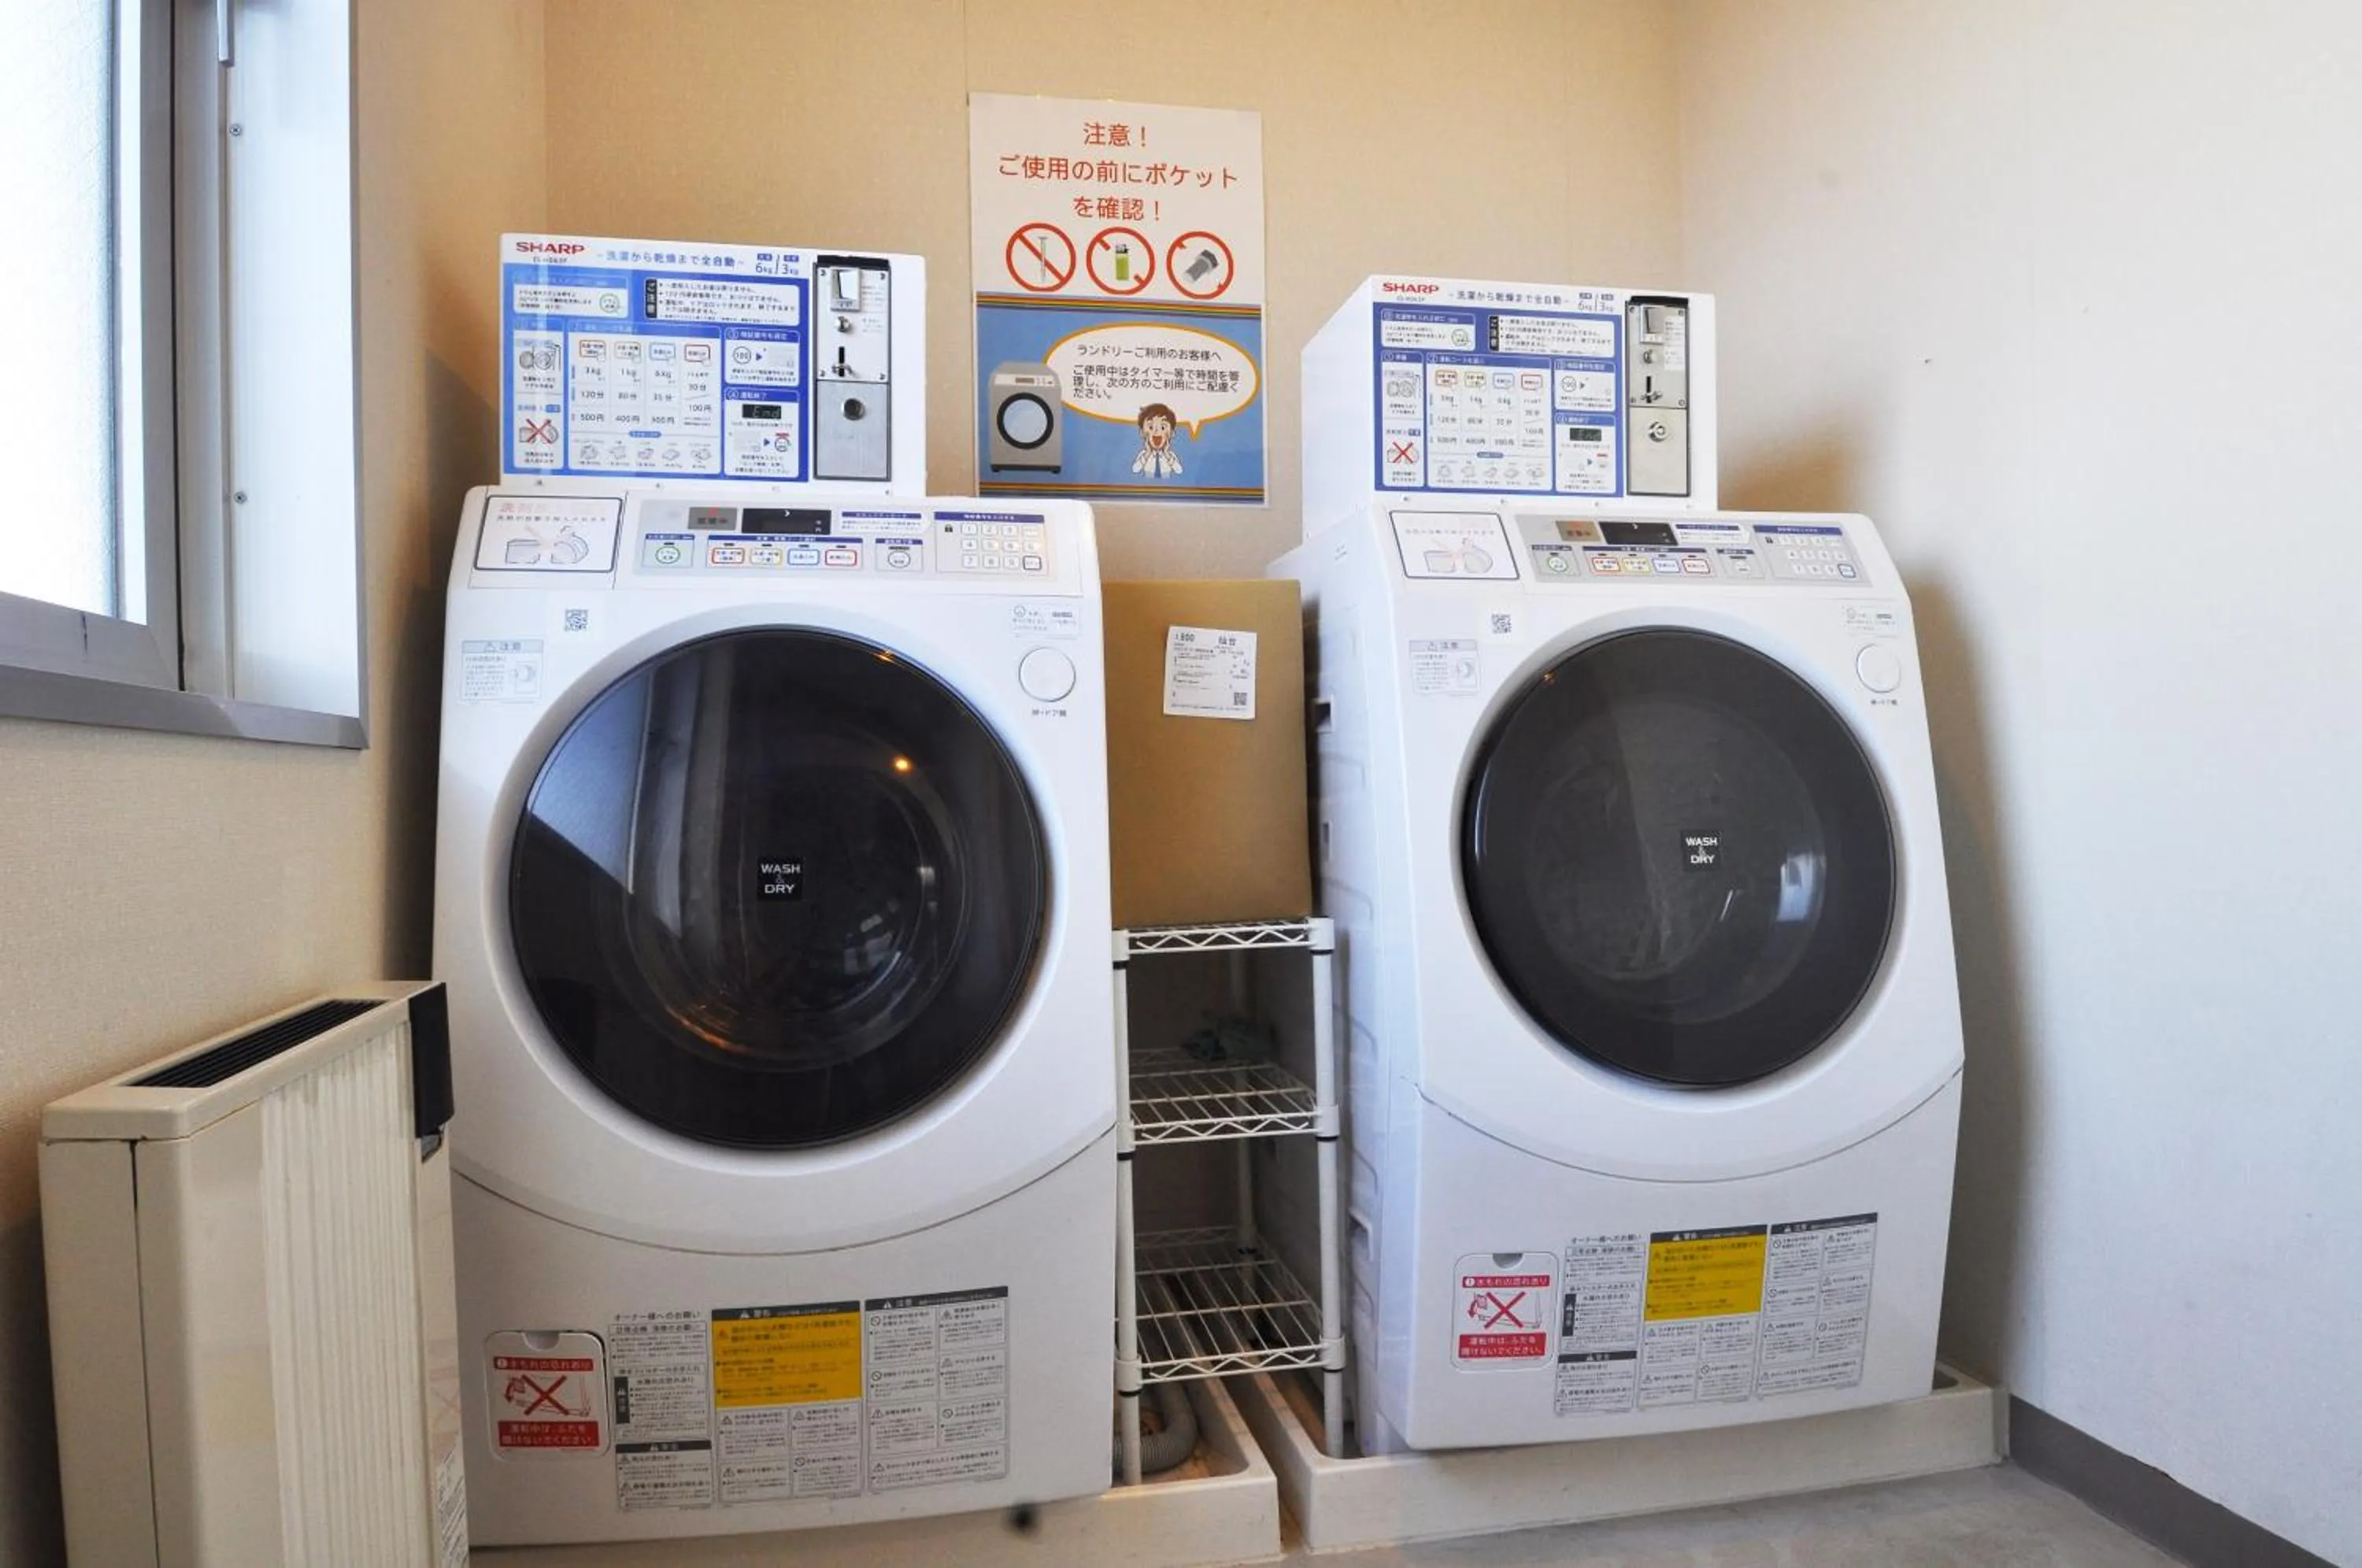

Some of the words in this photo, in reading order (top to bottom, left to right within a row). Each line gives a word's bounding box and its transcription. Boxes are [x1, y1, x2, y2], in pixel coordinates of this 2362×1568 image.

[1083, 124, 1146, 146] 注意！
[999, 157, 1237, 189] ご使用の前にポケット
[1074, 197, 1160, 221] を確認！
[516, 242, 585, 254] SHARP
[1383, 283, 1439, 293] SHARP
[1077, 344, 1222, 361] ランドリーご利用のお客様へ
[1686, 838, 1717, 846] WASH
[1690, 855, 1715, 864] DRY
[761, 864, 801, 874] WASH
[765, 884, 794, 893] DRY
